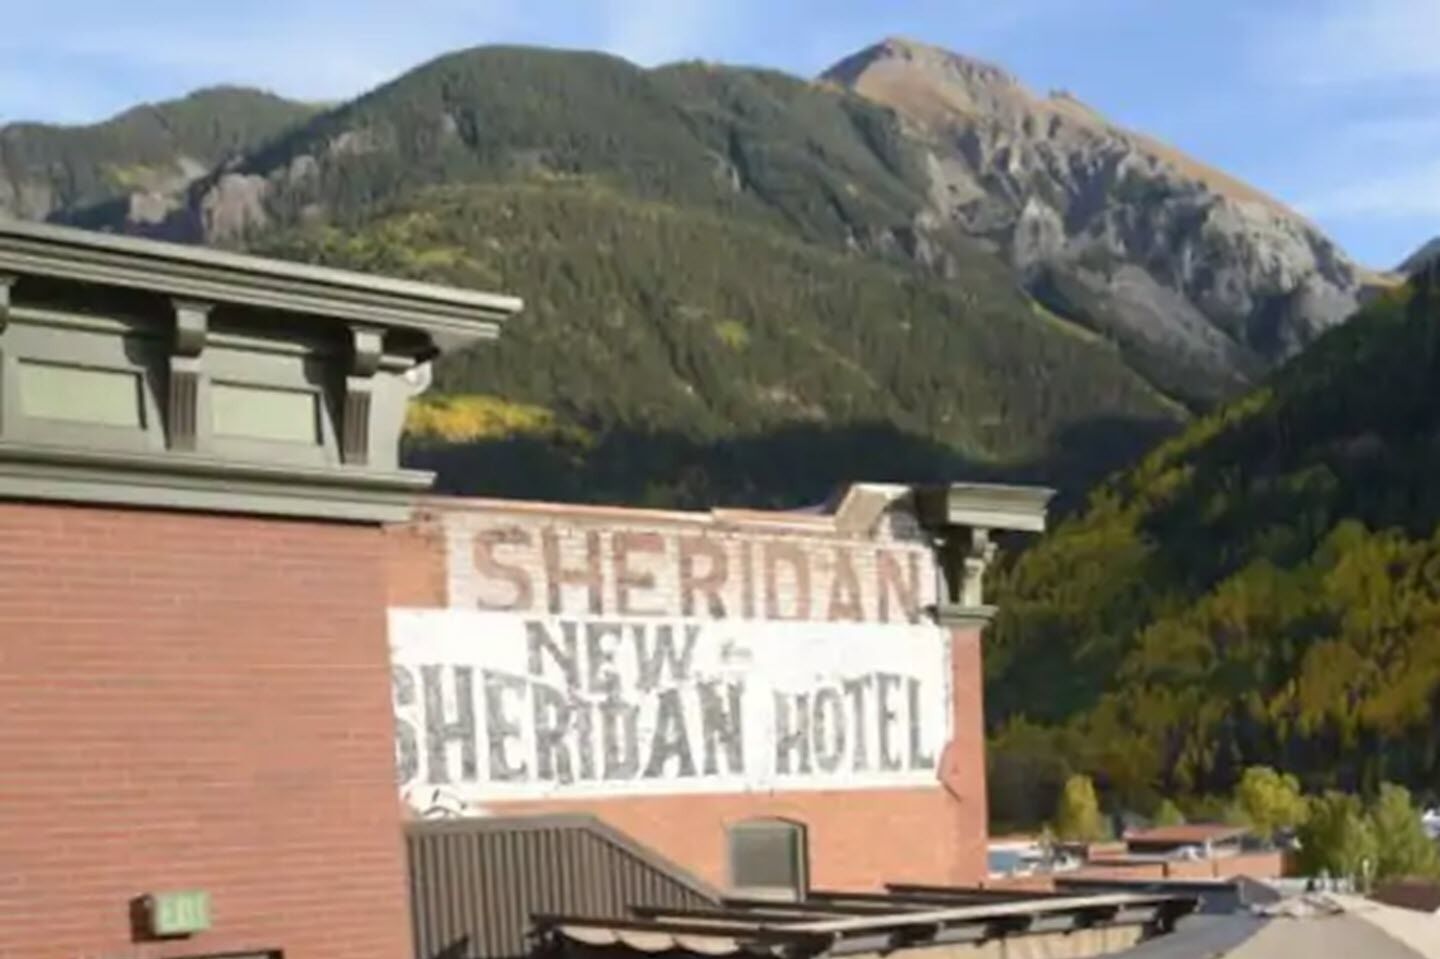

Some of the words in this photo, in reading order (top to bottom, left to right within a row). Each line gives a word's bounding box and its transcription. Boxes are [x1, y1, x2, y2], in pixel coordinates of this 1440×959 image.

[474, 525, 924, 624] SHERIDAN
[526, 620, 699, 692] NEW
[772, 672, 935, 774] HOTEL
